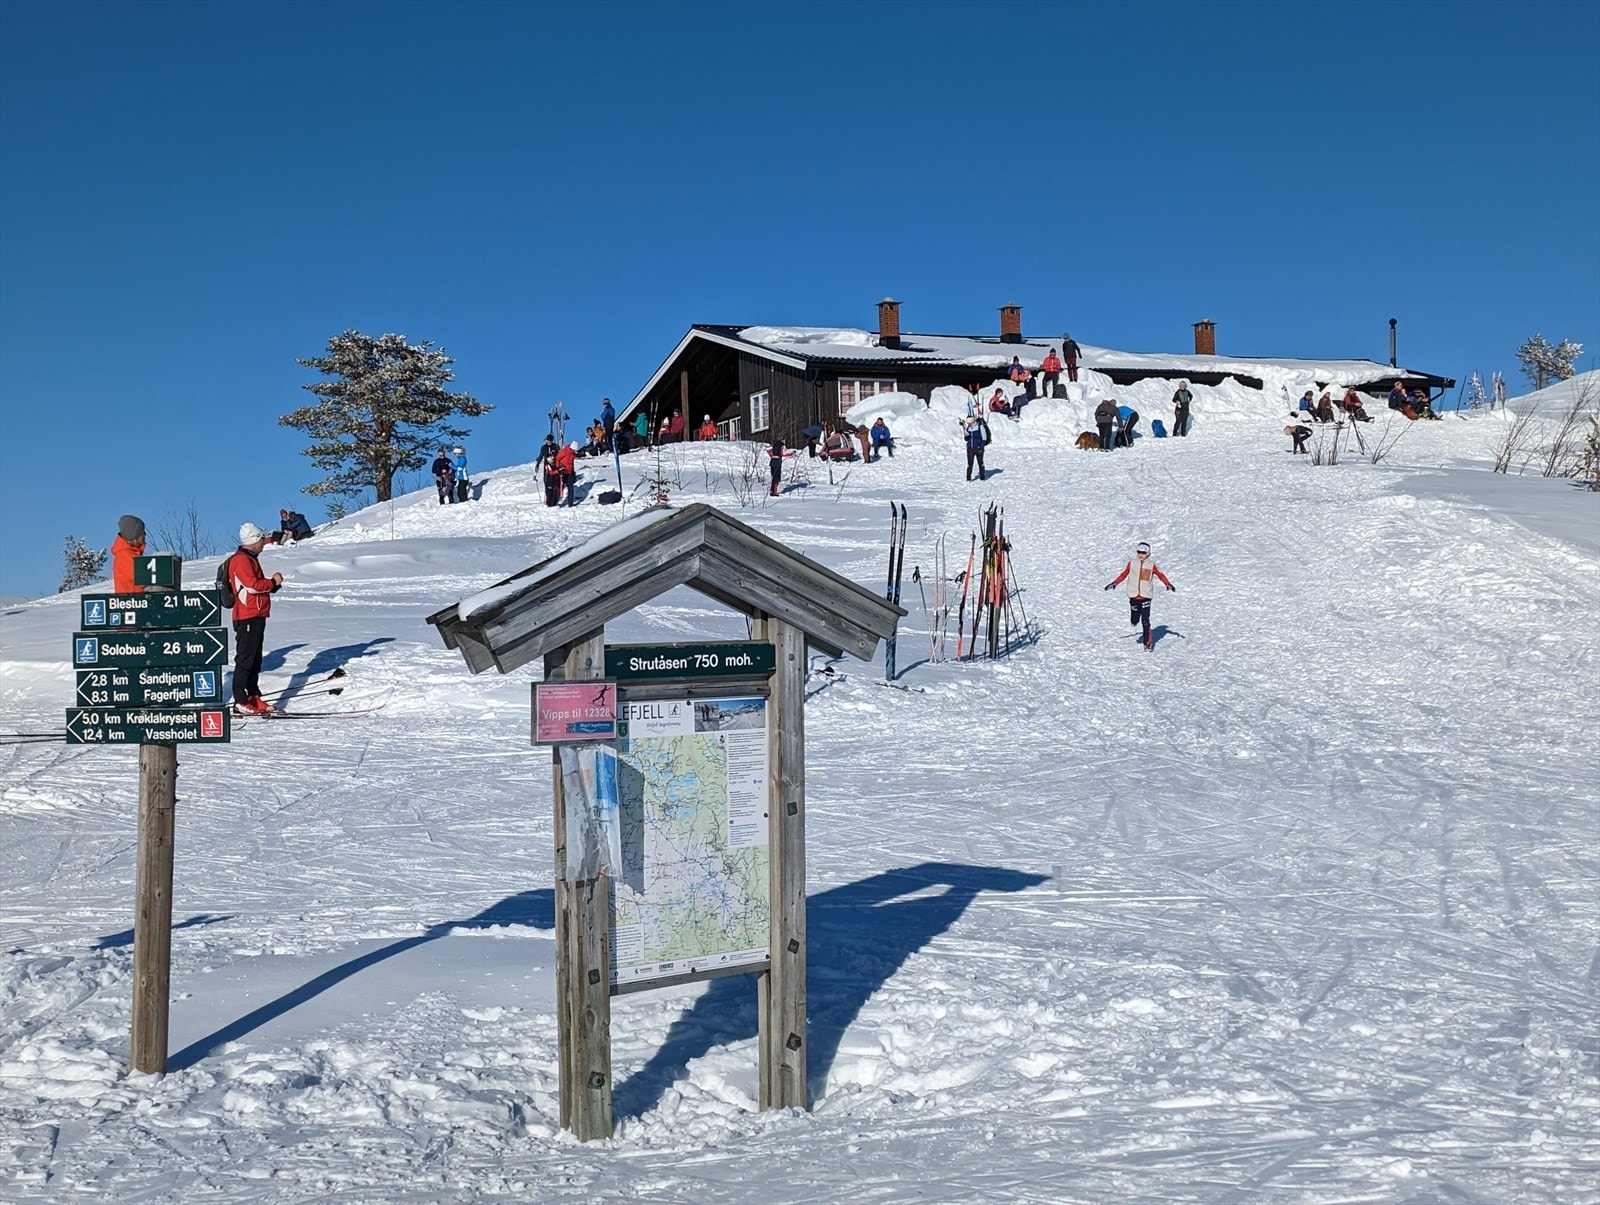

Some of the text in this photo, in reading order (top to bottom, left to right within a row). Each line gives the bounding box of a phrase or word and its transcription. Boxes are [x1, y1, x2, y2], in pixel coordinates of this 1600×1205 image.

[147, 558, 157, 584] 1
[108, 595, 201, 610] Blestua 2,1 km
[101, 642, 204, 656] Solobua 2,6 km
[629, 653, 754, 671] Strutåsen 750 moh.
[91, 673, 190, 687] 2,8 km Sandtjenn
[91, 688, 191, 704] 8,3 km Fagerfjell
[82, 712, 198, 726] 5,0 km Krøklakrysset
[542, 707, 611, 720] Vipps til 12328
[82, 728, 198, 741] 12,4 km Vassholet
